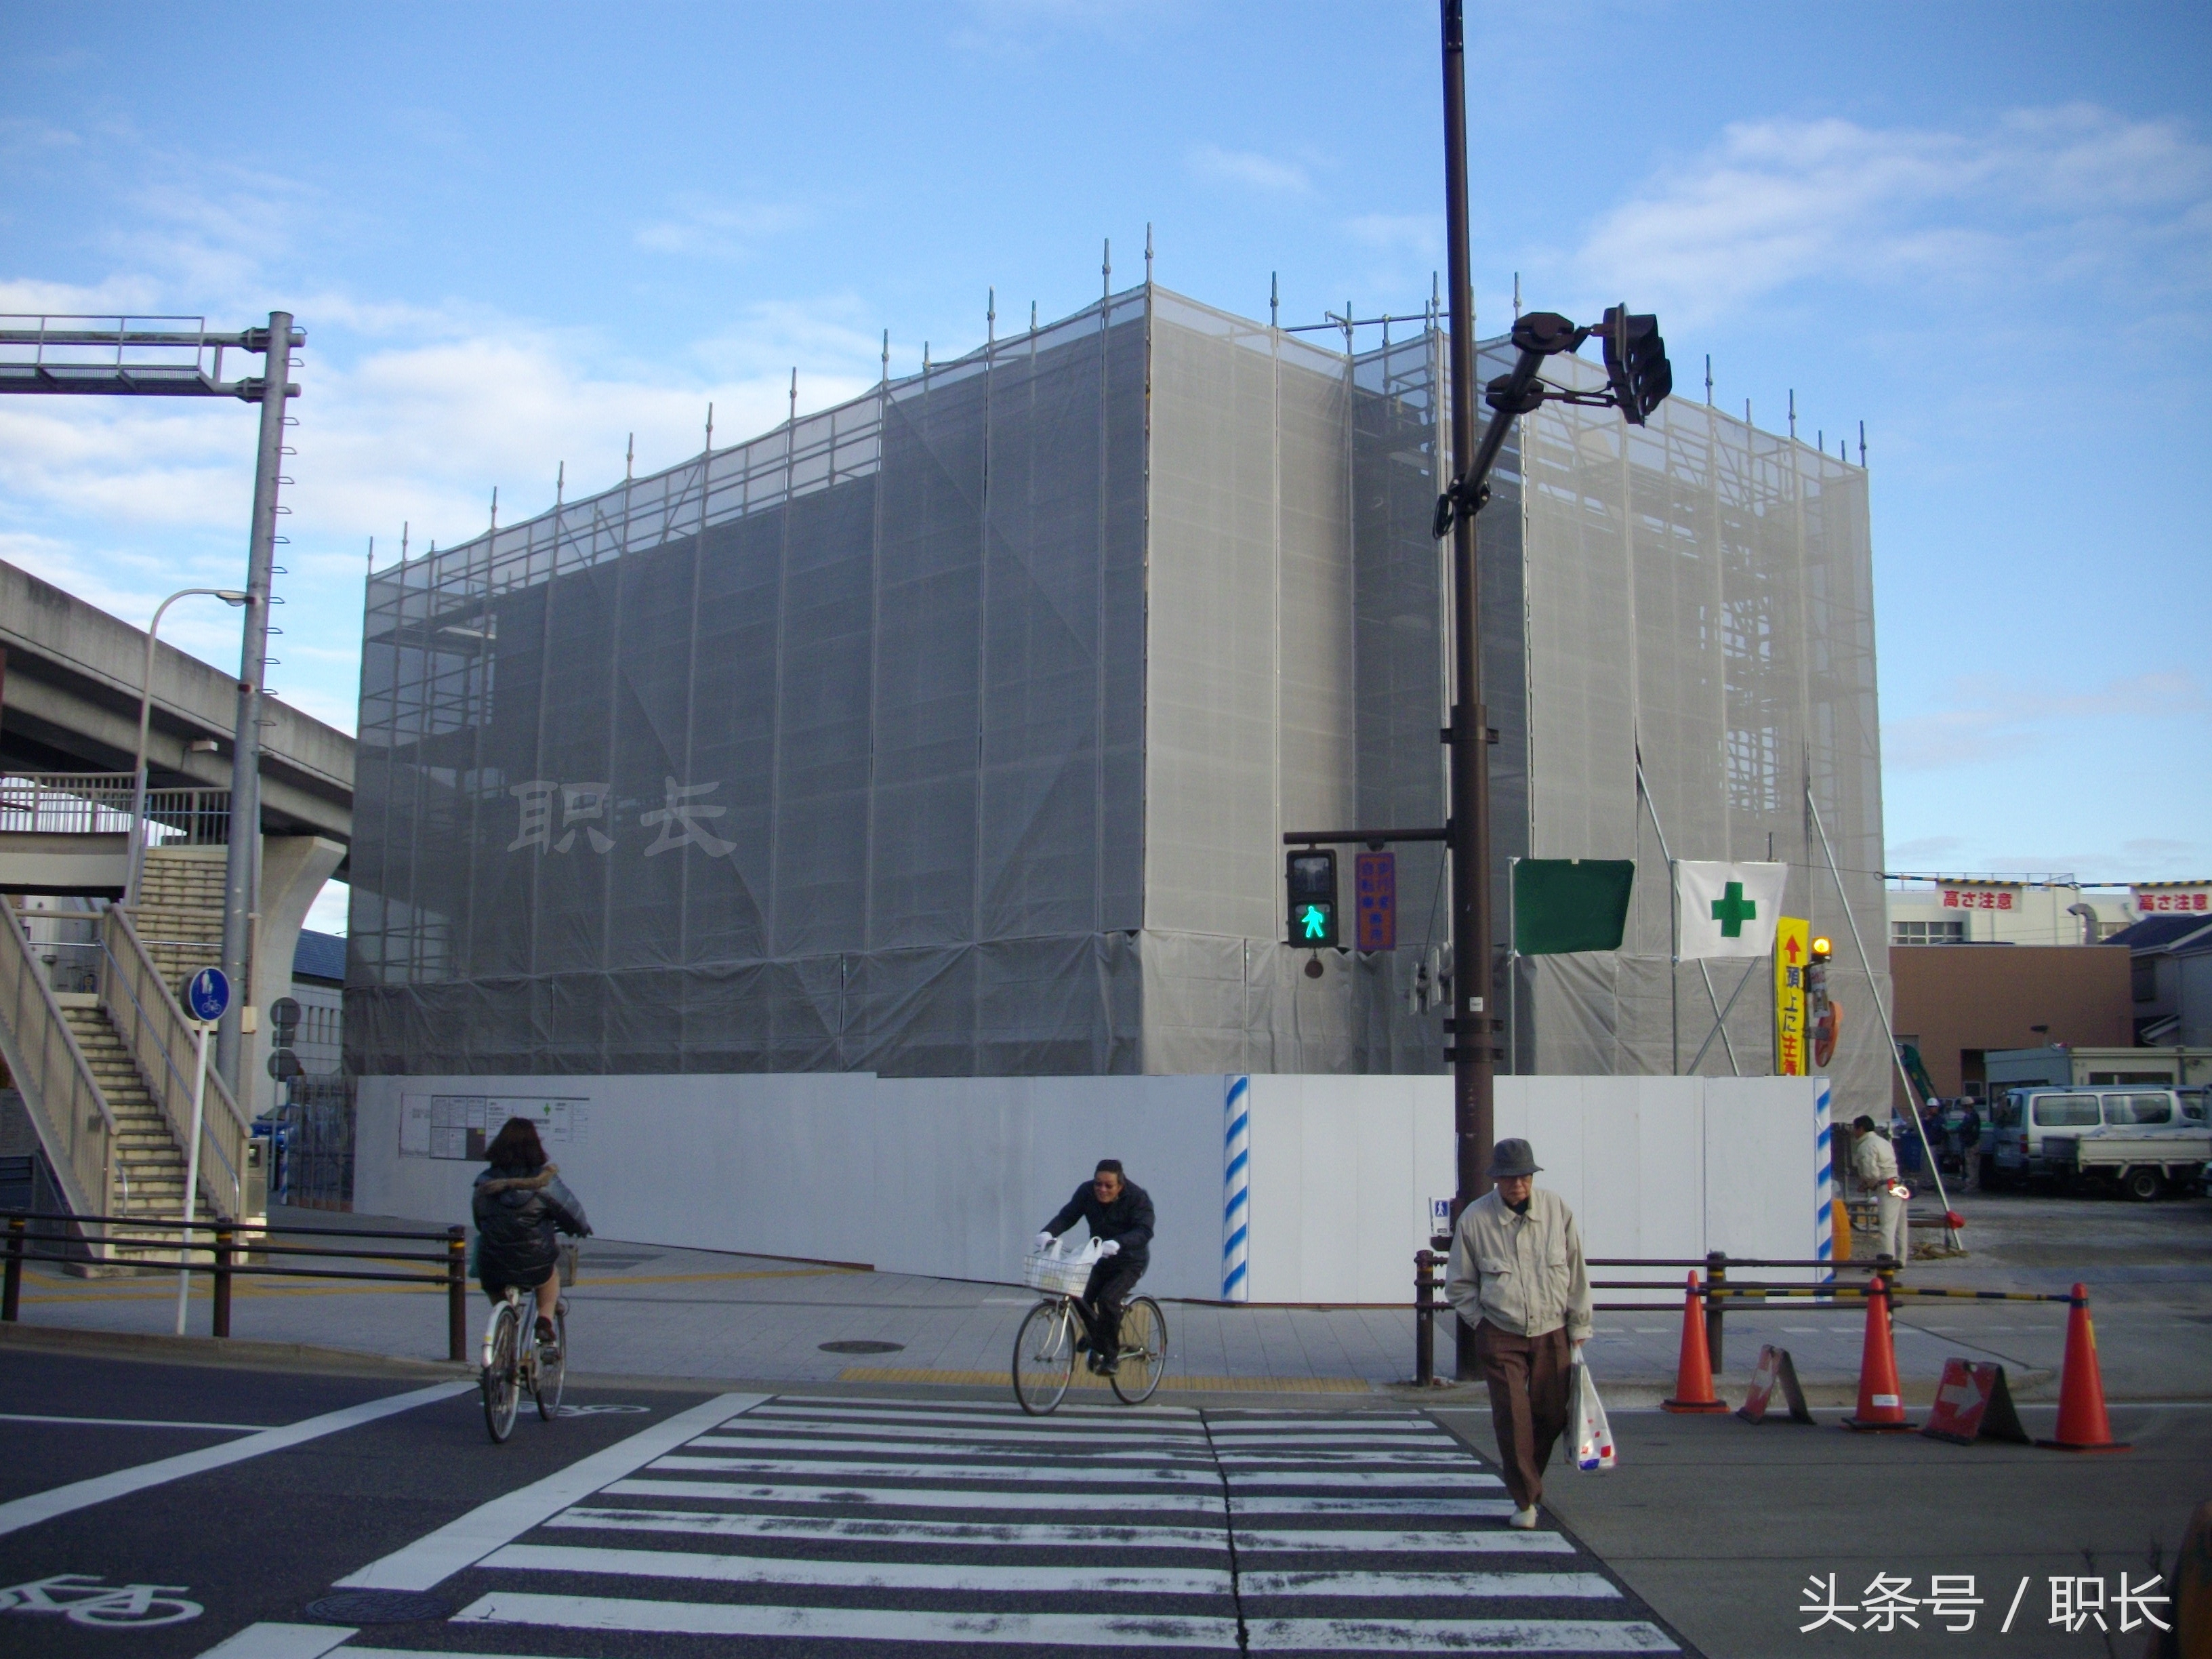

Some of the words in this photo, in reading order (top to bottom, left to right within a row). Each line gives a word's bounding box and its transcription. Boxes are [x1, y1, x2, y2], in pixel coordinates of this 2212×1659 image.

[1943, 890, 2013, 910] 高さ注意
[2139, 893, 2207, 912] 高さ注意
